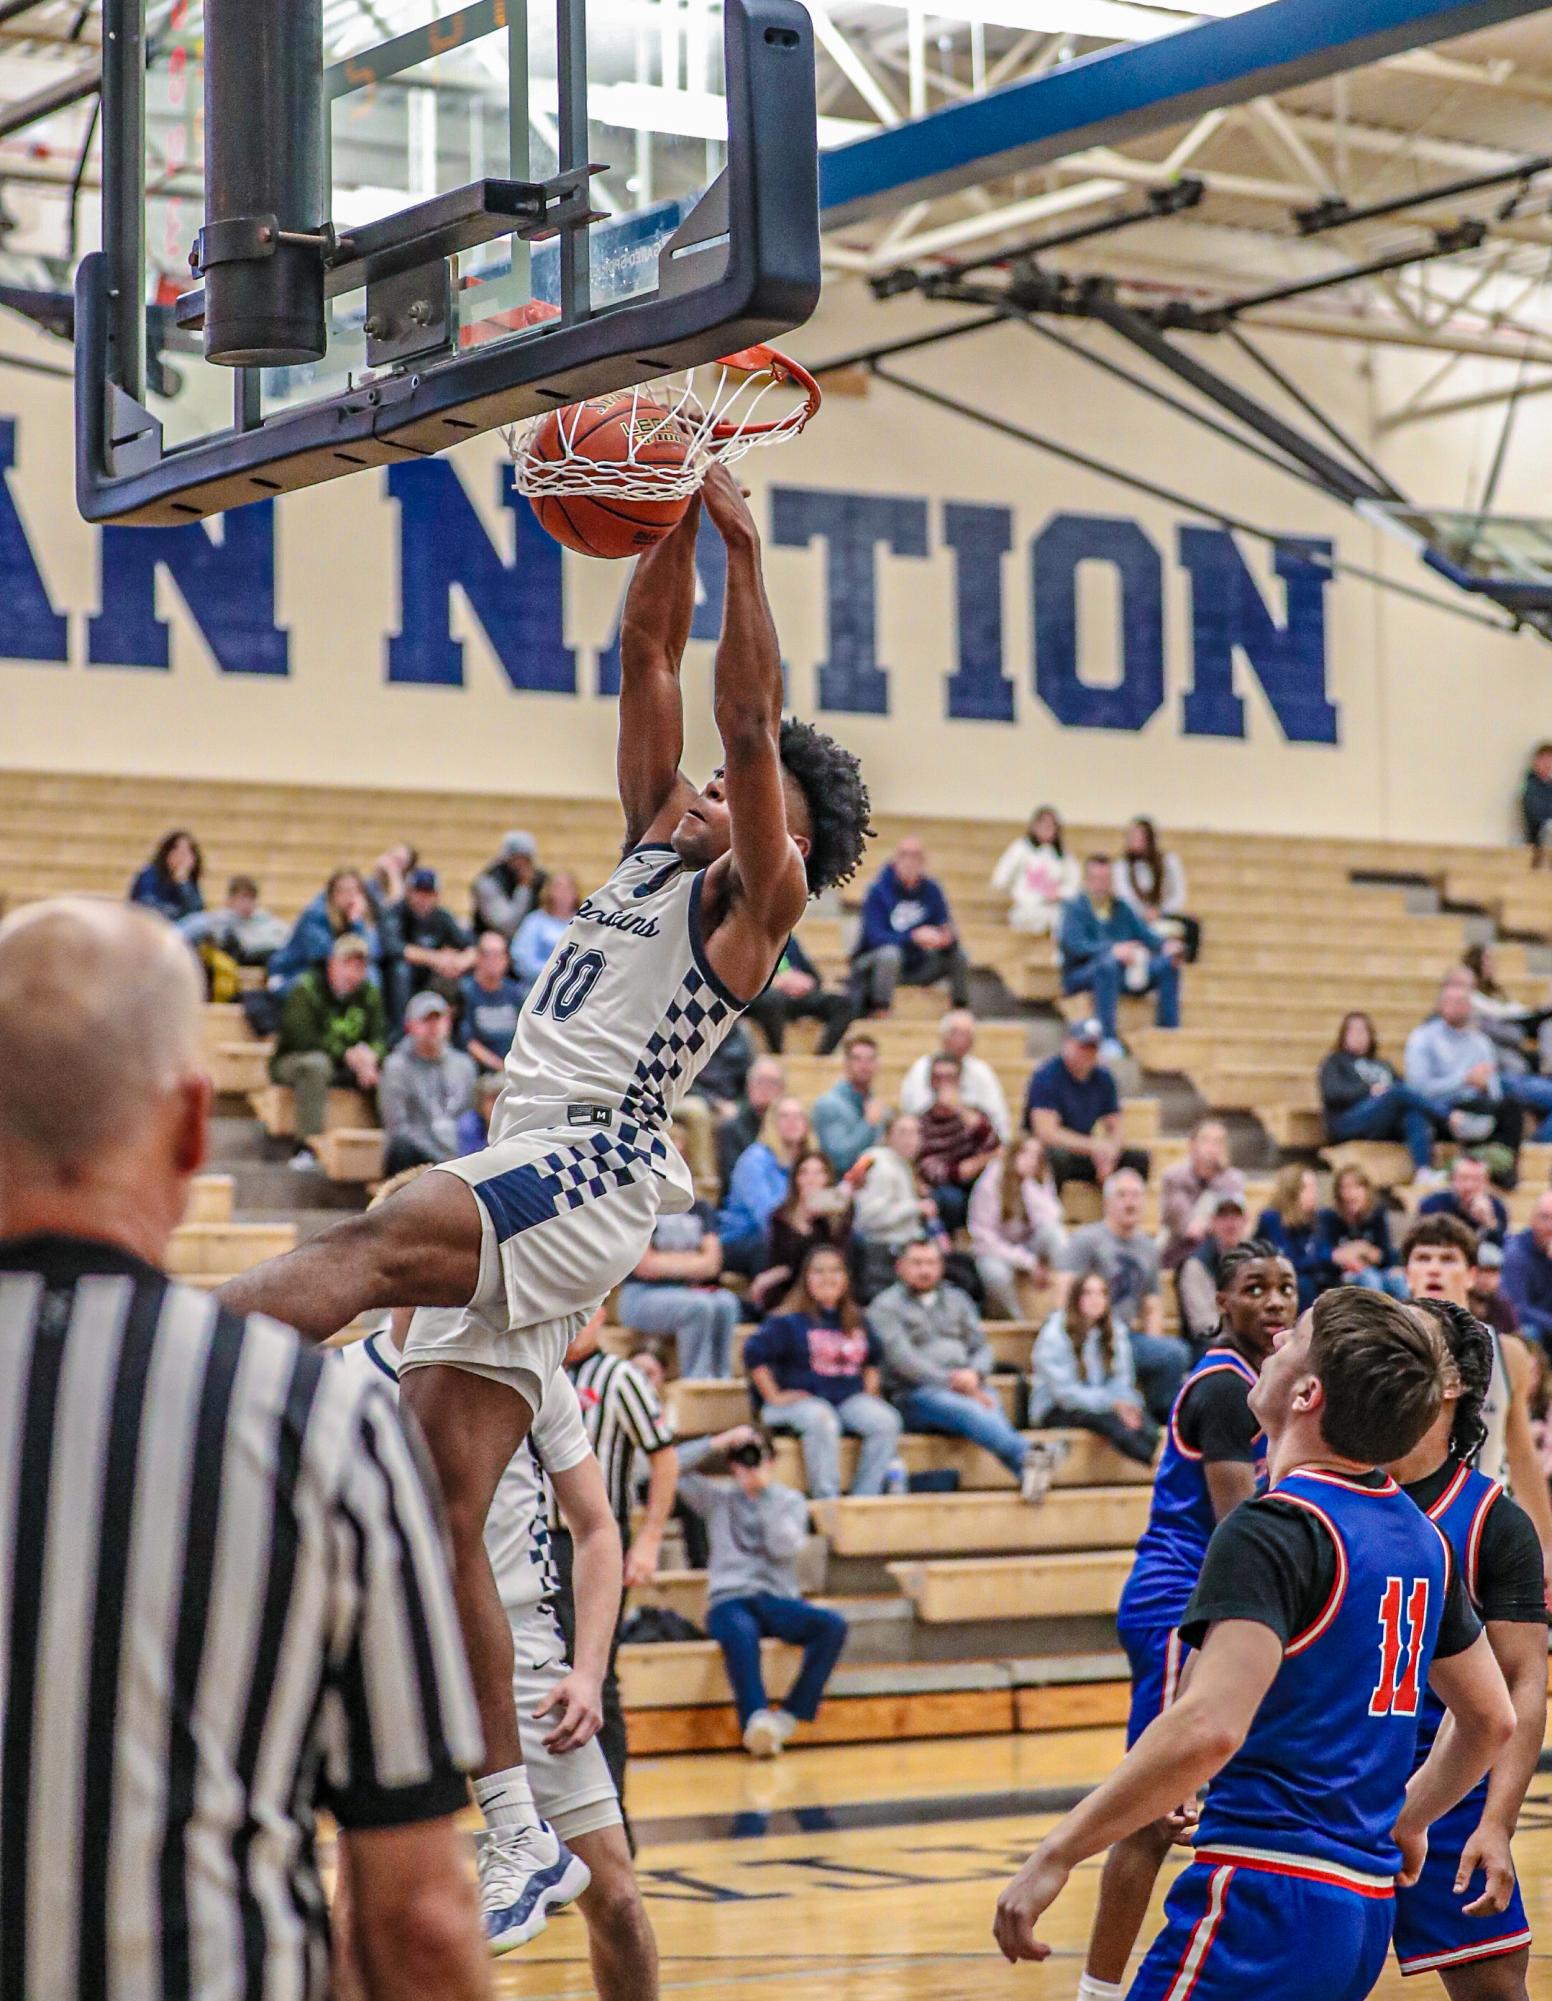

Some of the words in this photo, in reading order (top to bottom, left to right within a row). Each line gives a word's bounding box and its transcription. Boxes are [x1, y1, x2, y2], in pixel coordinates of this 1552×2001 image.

[384, 457, 1341, 747] NTION
[531, 941, 607, 1022] 10
[1368, 1576, 1429, 1717] 11
